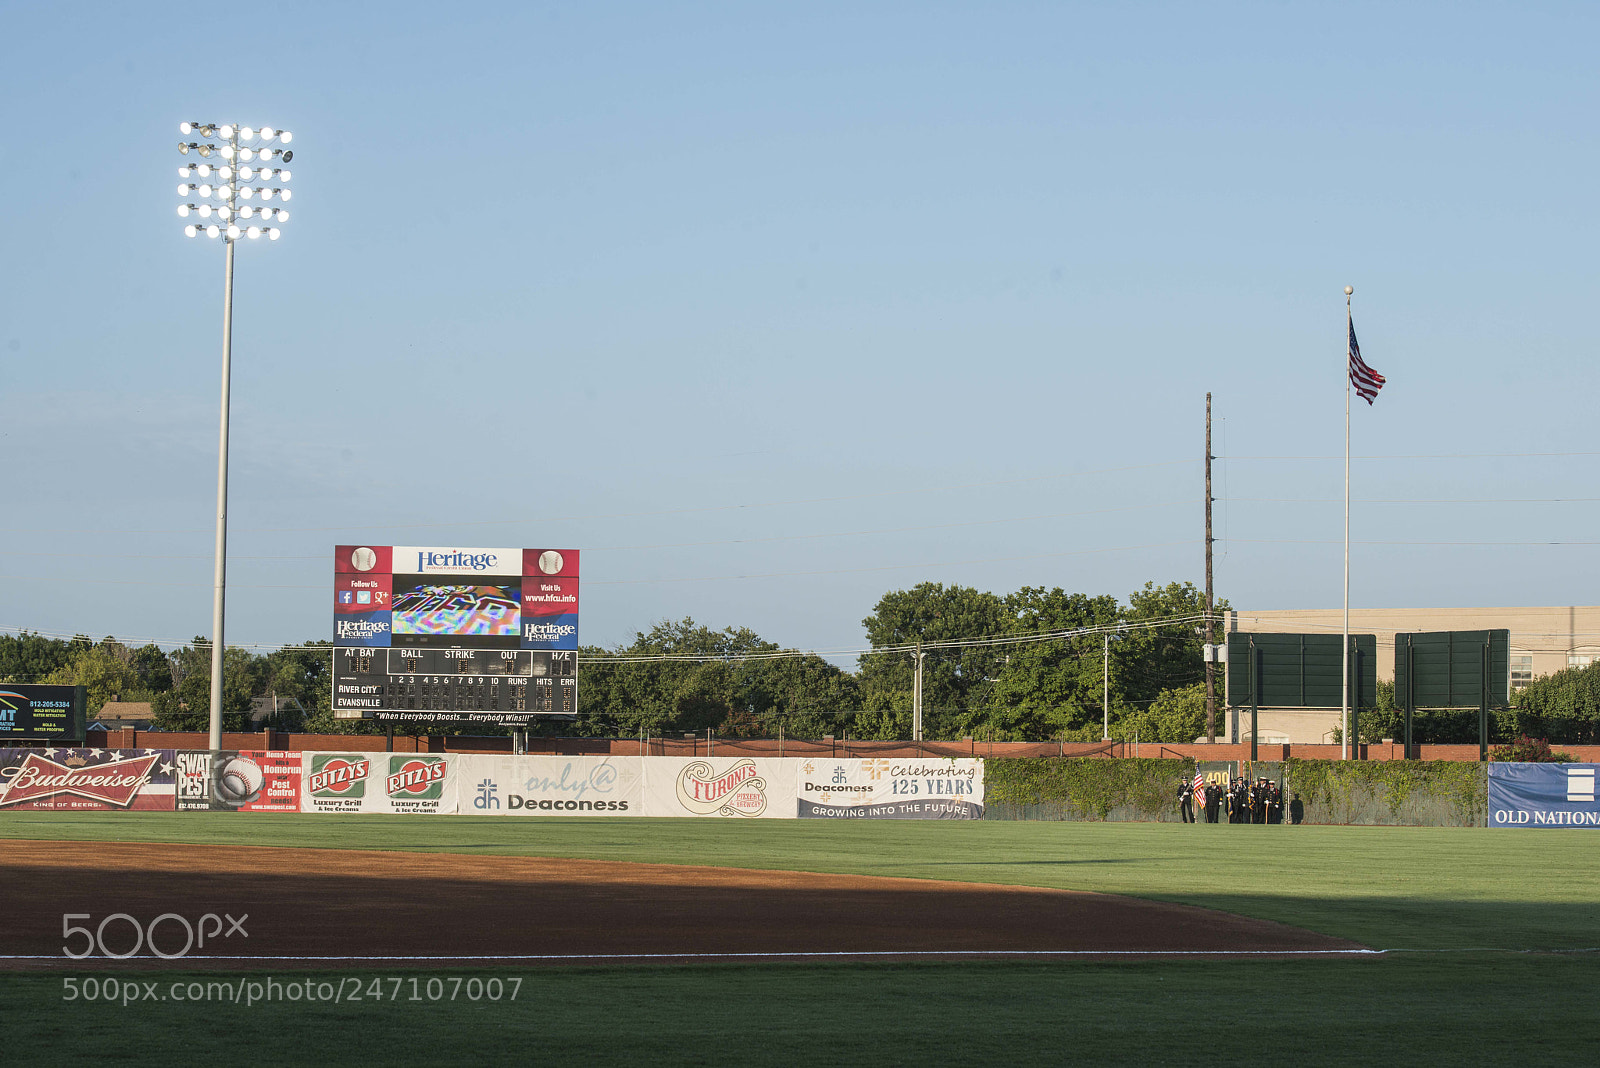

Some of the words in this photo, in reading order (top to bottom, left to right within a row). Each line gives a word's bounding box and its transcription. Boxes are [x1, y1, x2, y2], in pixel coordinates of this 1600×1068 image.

[417, 549, 498, 573] Heritage
[540, 584, 553, 592] Visit
[554, 584, 561, 592] Us
[525, 594, 576, 603] www.hfcu.info
[336, 619, 390, 635] Heritage
[524, 622, 576, 638] Heritage
[340, 630, 373, 639] Federal
[528, 633, 560, 642] Federal
[344, 648, 355, 657] AT
[359, 648, 376, 657] BAT
[401, 650, 424, 658] BALL
[444, 650, 475, 659] STRIKE
[500, 652, 518, 660] OUT
[551, 652, 571, 660] H/E
[536, 678, 553, 686] HITS
[338, 686, 360, 694] RIVER
[361, 686, 377, 694] CITY
[337, 698, 380, 707] EVANSVILLE
[399, 714, 436, 722] Everybody
[176, 754, 212, 776] SWAT
[263, 765, 302, 774] Homerun
[890, 766, 975, 779] Celebrating
[0, 766, 152, 789] Budweiser
[177, 768, 211, 796] PEST
[1205, 772, 1229, 785] 400
[272, 780, 290, 789] Pest
[692, 766, 757, 801] TURONI'S
[804, 782, 874, 792] Deaconess
[892, 780, 919, 795] 125
[927, 780, 973, 795] YEARS
[267, 788, 296, 797] Control
[508, 794, 629, 811] Deaconess
[812, 806, 865, 817] GROWING
[869, 807, 895, 815] INTO
[899, 804, 921, 813] THE
[924, 804, 968, 815] FUTURE
[1495, 810, 1530, 824] OLD
